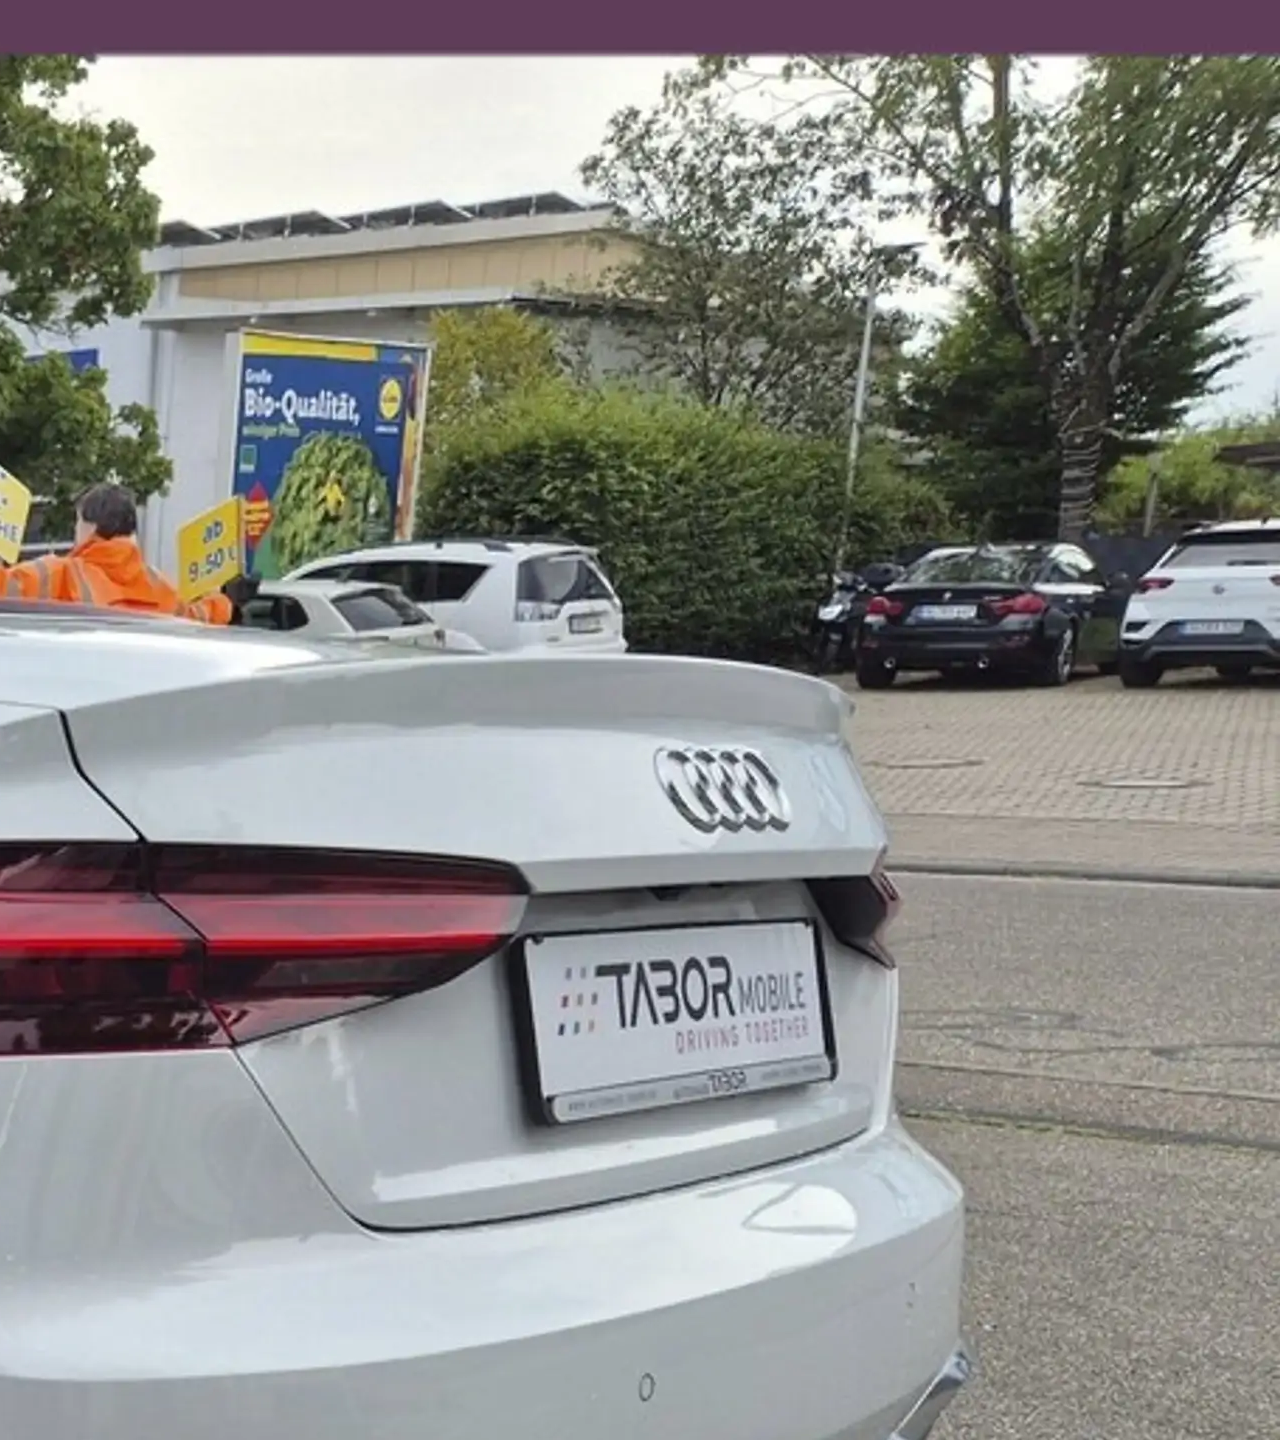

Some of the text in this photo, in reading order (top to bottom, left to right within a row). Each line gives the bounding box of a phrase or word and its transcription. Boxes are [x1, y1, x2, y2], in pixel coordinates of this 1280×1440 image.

[244, 387, 360, 426] Bio-Qualität,
[203, 521, 223, 544] ab
[595, 955, 807, 1029] TABOR MOBILE
[675, 1016, 809, 1053] DRIVING TOGETHER
